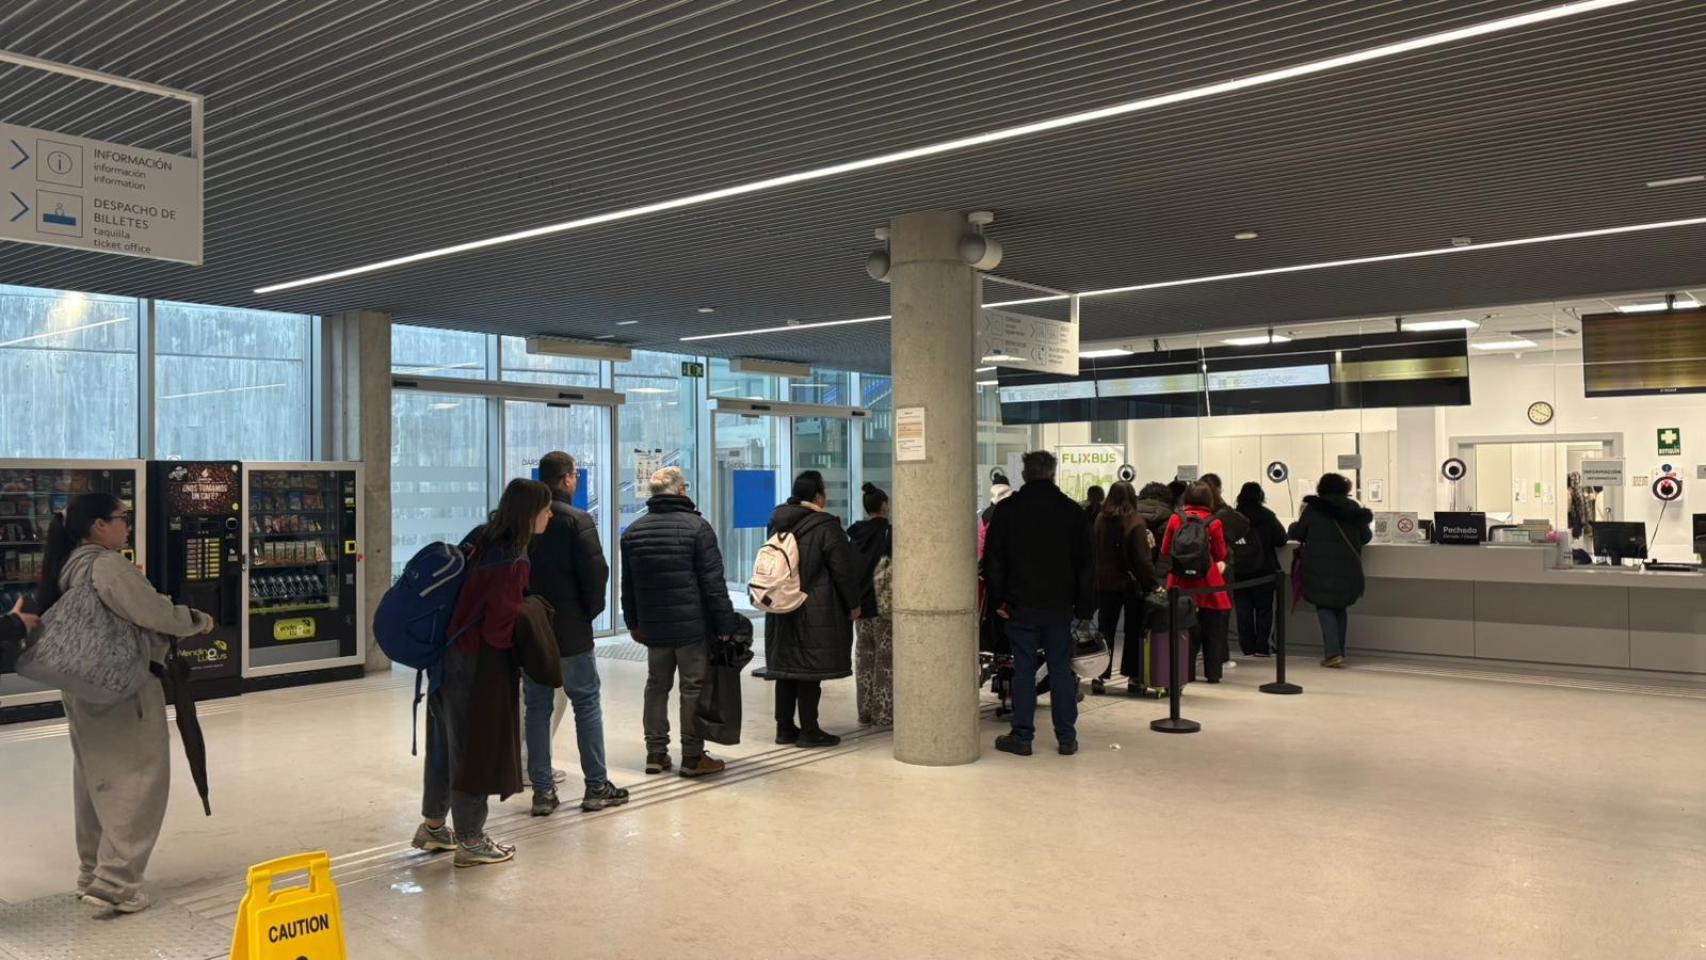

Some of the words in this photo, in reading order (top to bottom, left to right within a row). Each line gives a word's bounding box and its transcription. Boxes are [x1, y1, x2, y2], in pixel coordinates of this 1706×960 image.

[94, 148, 173, 171] INFORMACIÓN
[94, 174, 146, 191] information
[94, 198, 159, 217] DESPACHO
[161, 208, 177, 221] DE
[94, 212, 150, 230] BILLETES
[94, 227, 131, 240] taquilla
[94, 239, 122, 250] ticket
[124, 242, 152, 254] office
[1443, 526, 1478, 534] Pechado
[268, 914, 329, 943] CAUTION
